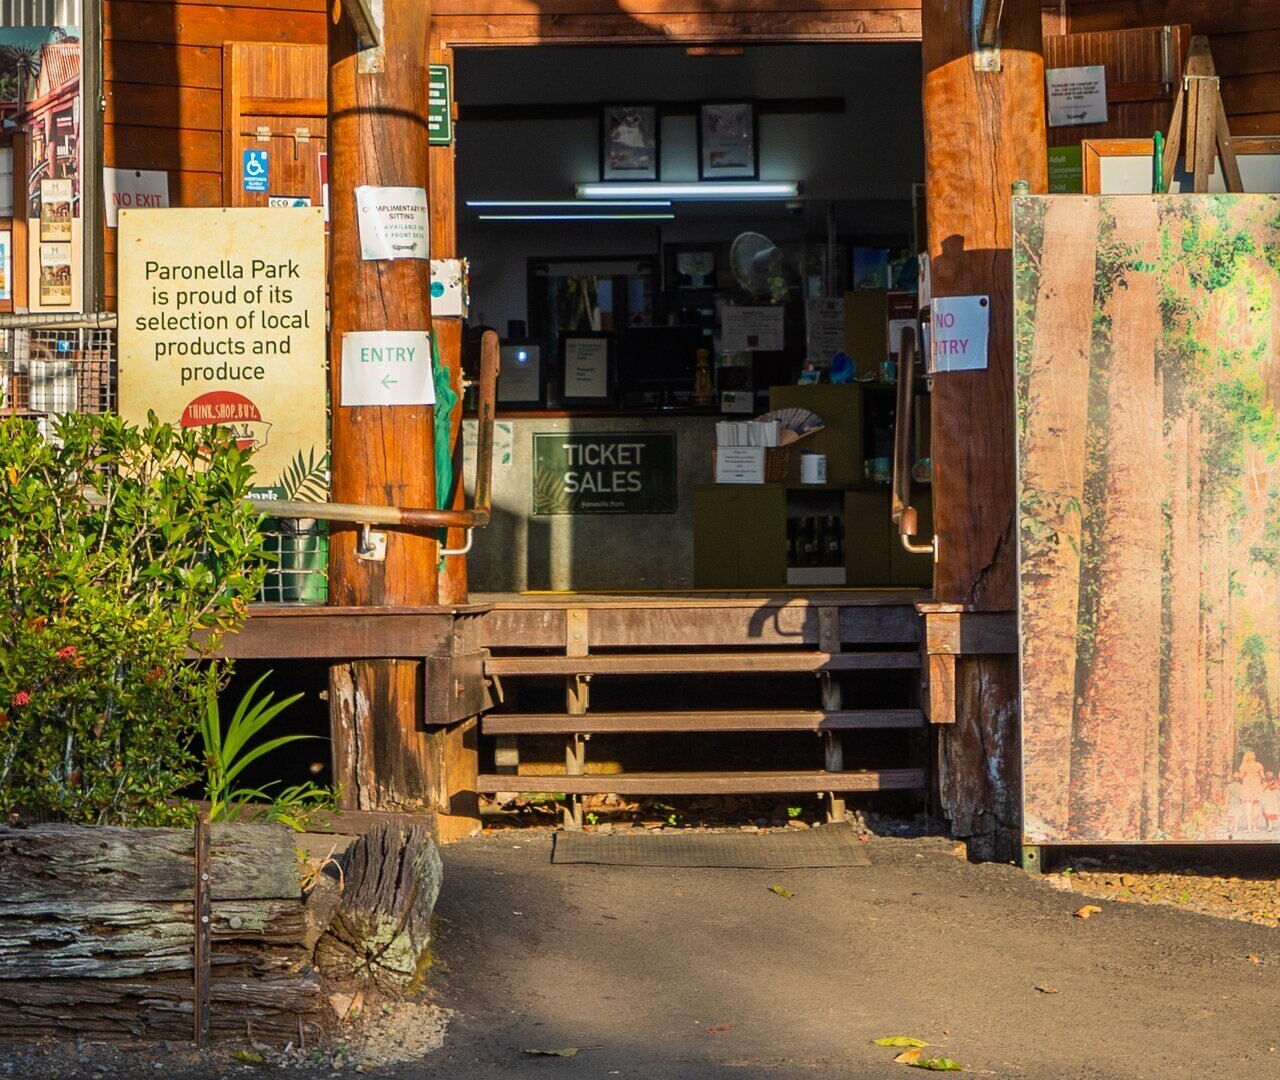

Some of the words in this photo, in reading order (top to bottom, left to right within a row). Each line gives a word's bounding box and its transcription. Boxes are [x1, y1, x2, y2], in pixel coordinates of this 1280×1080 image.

[112, 192, 132, 207] NO
[136, 193, 162, 207] EXIT
[389, 212, 415, 220] SITTING
[145, 260, 246, 281] Paronella
[251, 259, 300, 279] Park
[152, 284, 170, 305] is
[176, 284, 239, 312] proud
[243, 284, 263, 305] of
[266, 284, 294, 304] its
[135, 310, 231, 331] selection
[235, 310, 256, 330] of
[261, 308, 310, 330] local
[935, 312, 955, 328] NO
[154, 336, 246, 364] products
[252, 334, 291, 355] and
[360, 346, 416, 364] ENTRY
[180, 360, 265, 387] produce
[562, 443, 646, 466] TICKET
[563, 471, 642, 493] SALES
